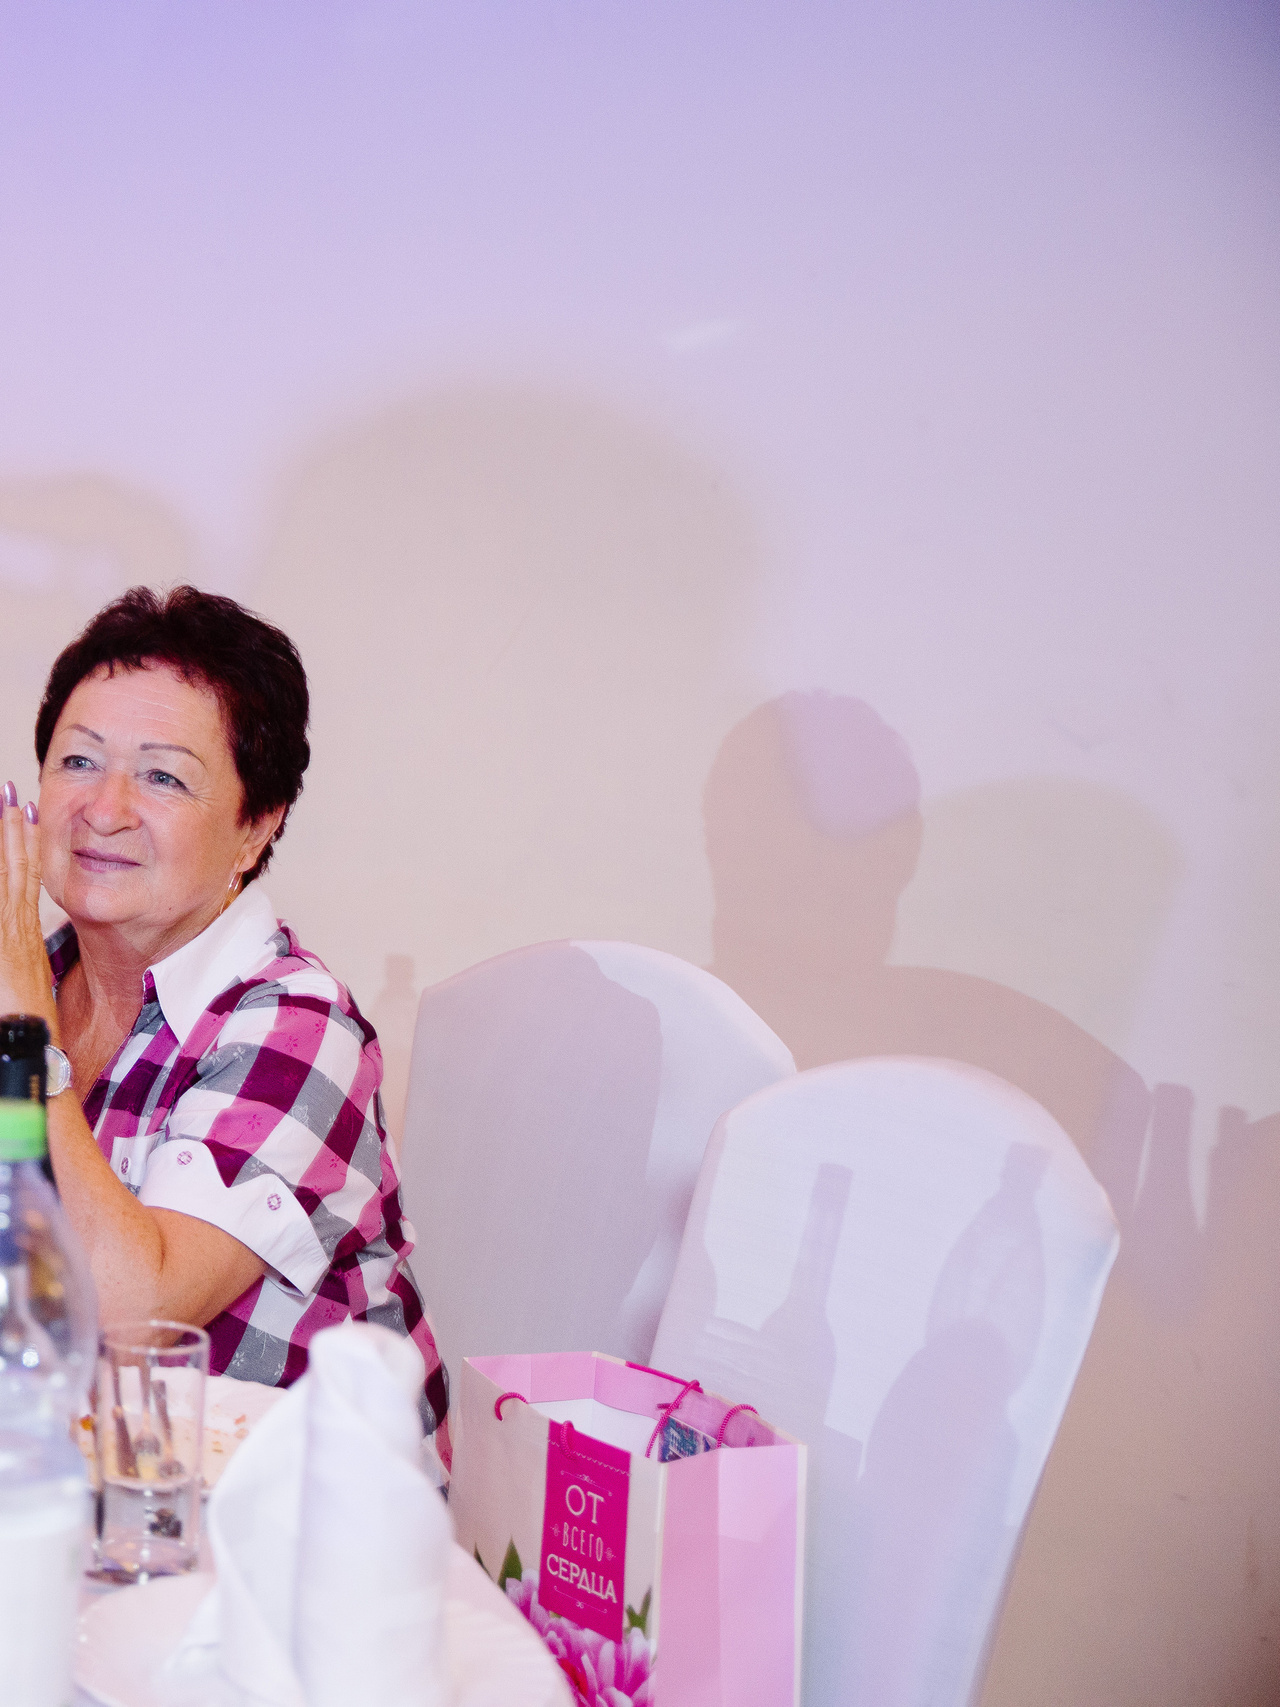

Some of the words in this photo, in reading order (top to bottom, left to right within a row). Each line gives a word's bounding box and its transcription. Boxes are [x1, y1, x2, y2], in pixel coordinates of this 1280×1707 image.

[565, 1484, 605, 1524] ОТ
[562, 1521, 604, 1562] ВСЕГО
[546, 1553, 618, 1603] СЕРДЦА
